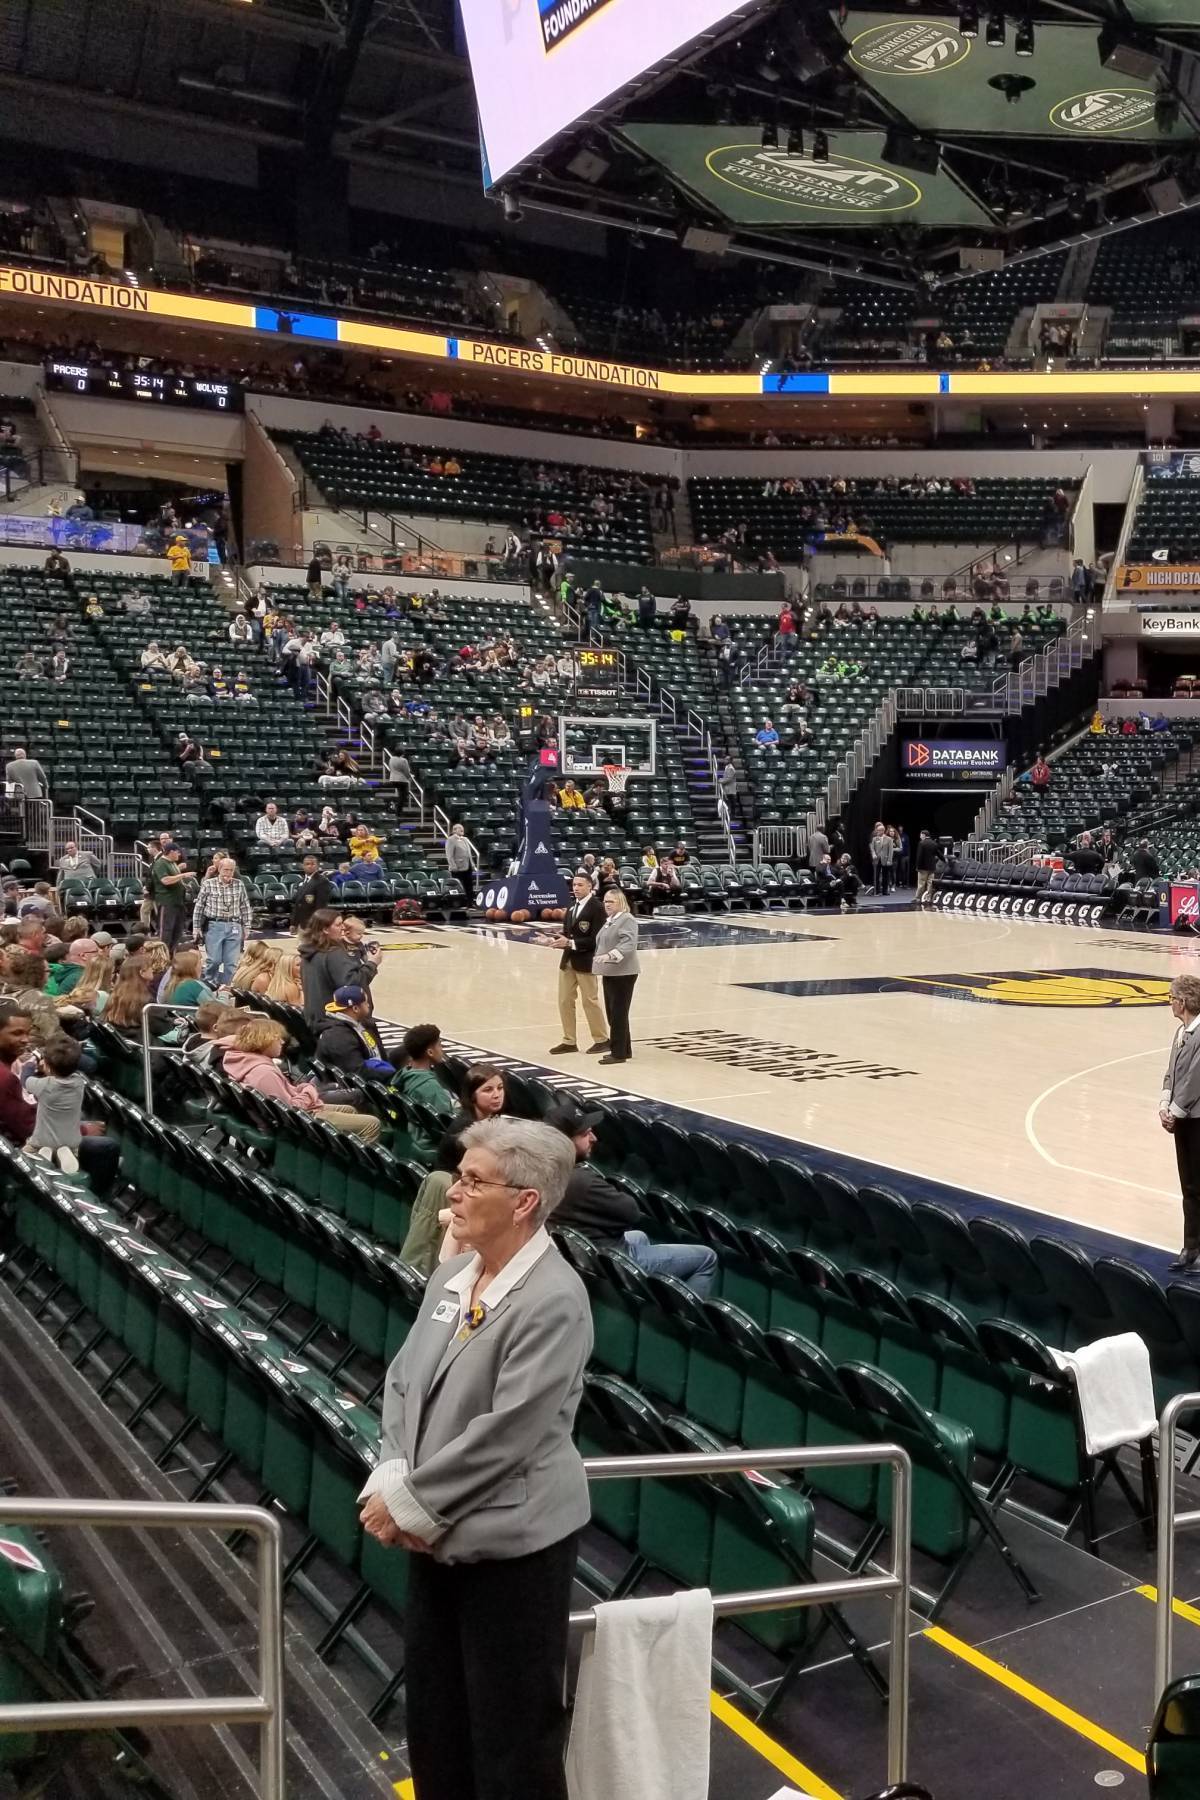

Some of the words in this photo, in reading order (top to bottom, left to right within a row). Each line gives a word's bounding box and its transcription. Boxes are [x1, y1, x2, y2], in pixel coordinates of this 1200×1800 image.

[721, 164, 875, 209] FIELDHOUSE
[737, 158, 848, 192] BANKERS
[848, 187, 887, 202] LIFE
[0, 268, 148, 311] FOUNDATION
[472, 343, 543, 370] PACERS
[552, 356, 659, 388] FOUNDATION
[53, 364, 88, 377] PACERS
[134, 375, 164, 388] 35:14
[196, 382, 228, 394] WOLVES
[78, 380, 85, 391] 0
[218, 397, 225, 407] 0
[1152, 453, 1164, 462] 101
[193, 561, 204, 572] 20
[1146, 571, 1172, 585] HIGH
[1142, 618, 1200, 632] KeyBank
[580, 652, 613, 666] 35:14
[932, 750, 999, 760] DATABANK
[943, 892, 952, 905] G
[954, 893, 964, 905] G
[965, 894, 975, 907] G
[976, 895, 986, 908] G
[988, 896, 999, 909] G
[1000, 898, 1011, 910] G
[1012, 899, 1022, 912] G
[1024, 900, 1035, 912] G
[1039, 902, 1049, 913] G
[1052, 903, 1063, 915] G
[1065, 904, 1076, 916] G
[1079, 905, 1090, 917] G
[1091, 906, 1102, 918] G
[1177, 896, 1200, 915] Lil
[632, 1036, 847, 1082] FIELDHOUSE
[673, 1029, 838, 1061] BANKERS
[815, 1060, 922, 1079] LIFE
